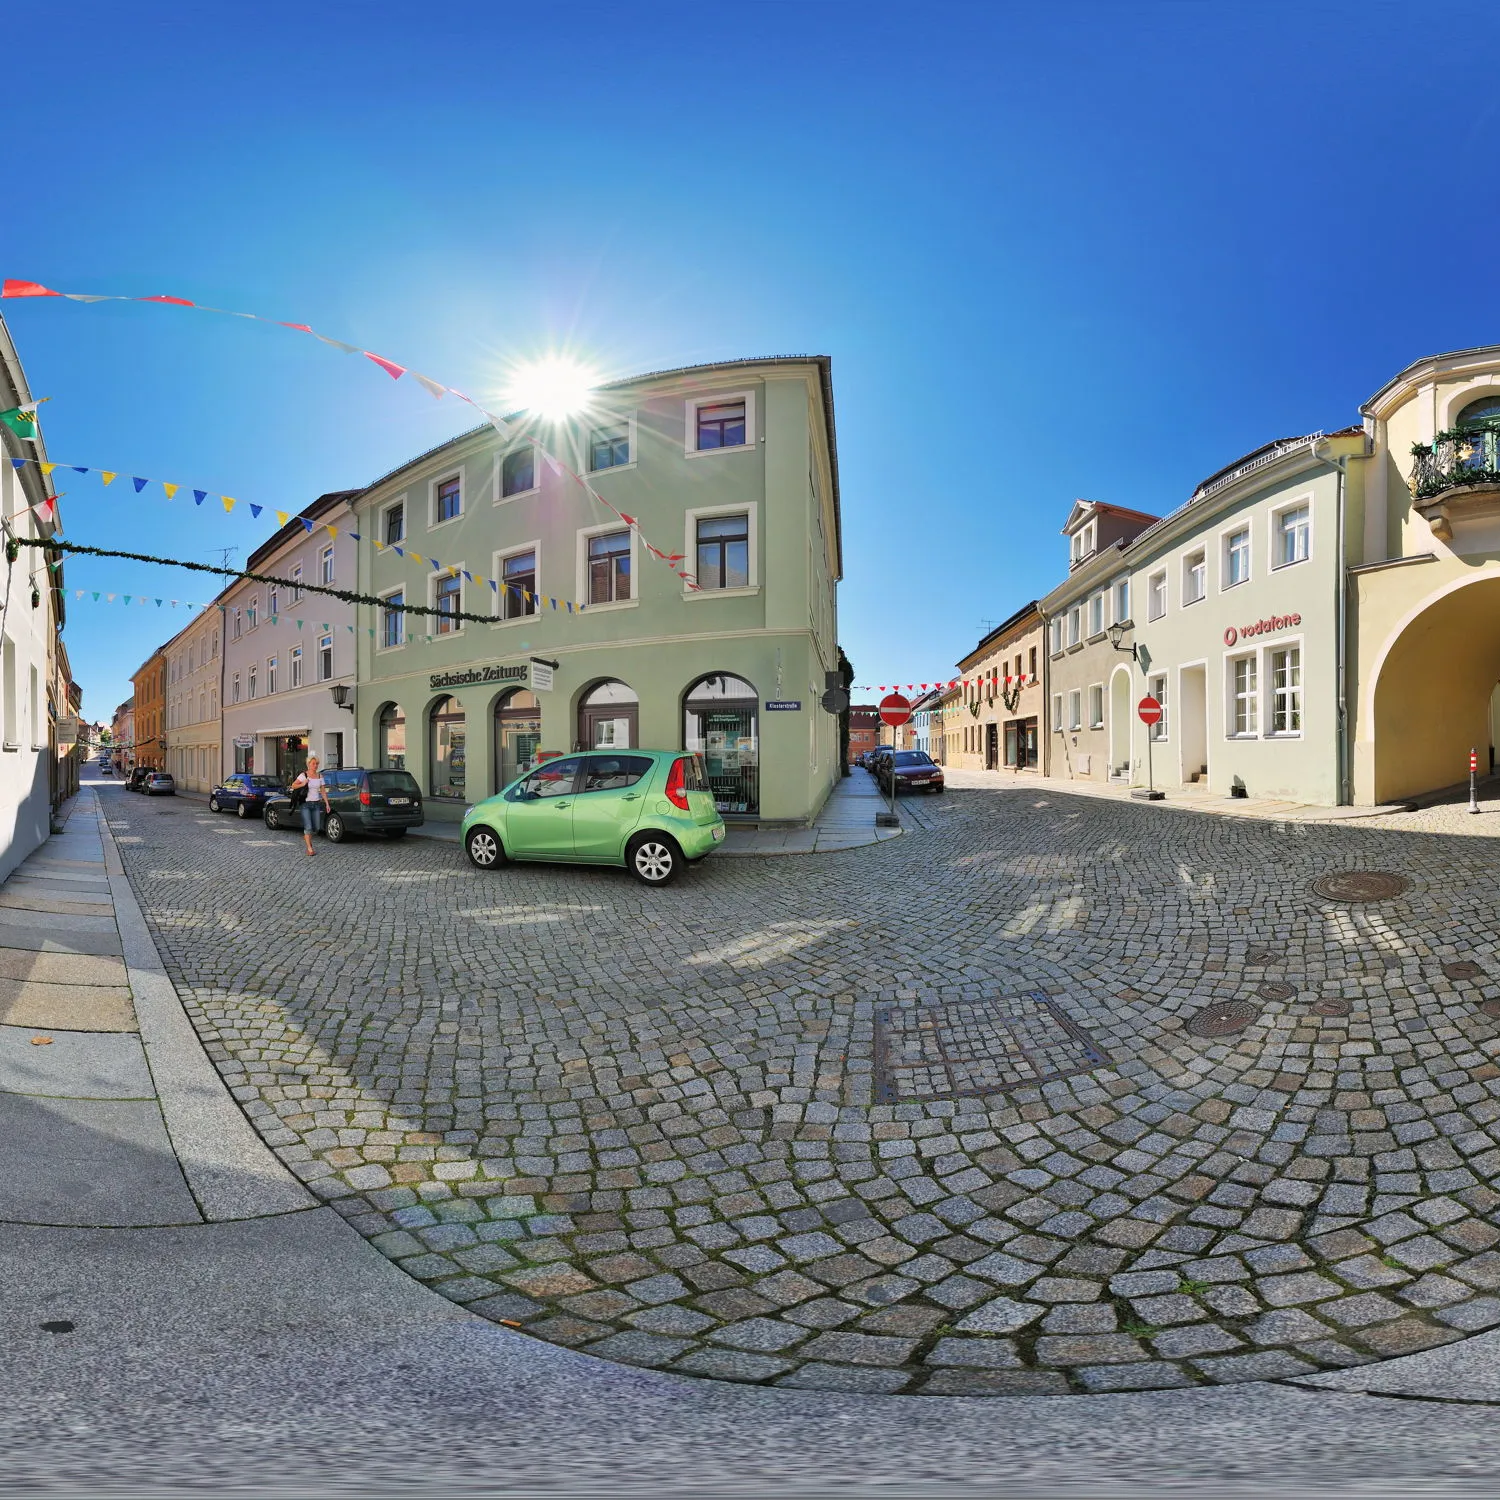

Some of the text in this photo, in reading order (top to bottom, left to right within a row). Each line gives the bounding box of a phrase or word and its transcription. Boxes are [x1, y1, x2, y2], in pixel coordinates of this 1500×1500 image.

[1240, 612, 1301, 639] vodafone
[430, 668, 482, 688] Sächsische
[482, 665, 528, 681] Zeitung
[769, 702, 798, 710] Klosterstraße
